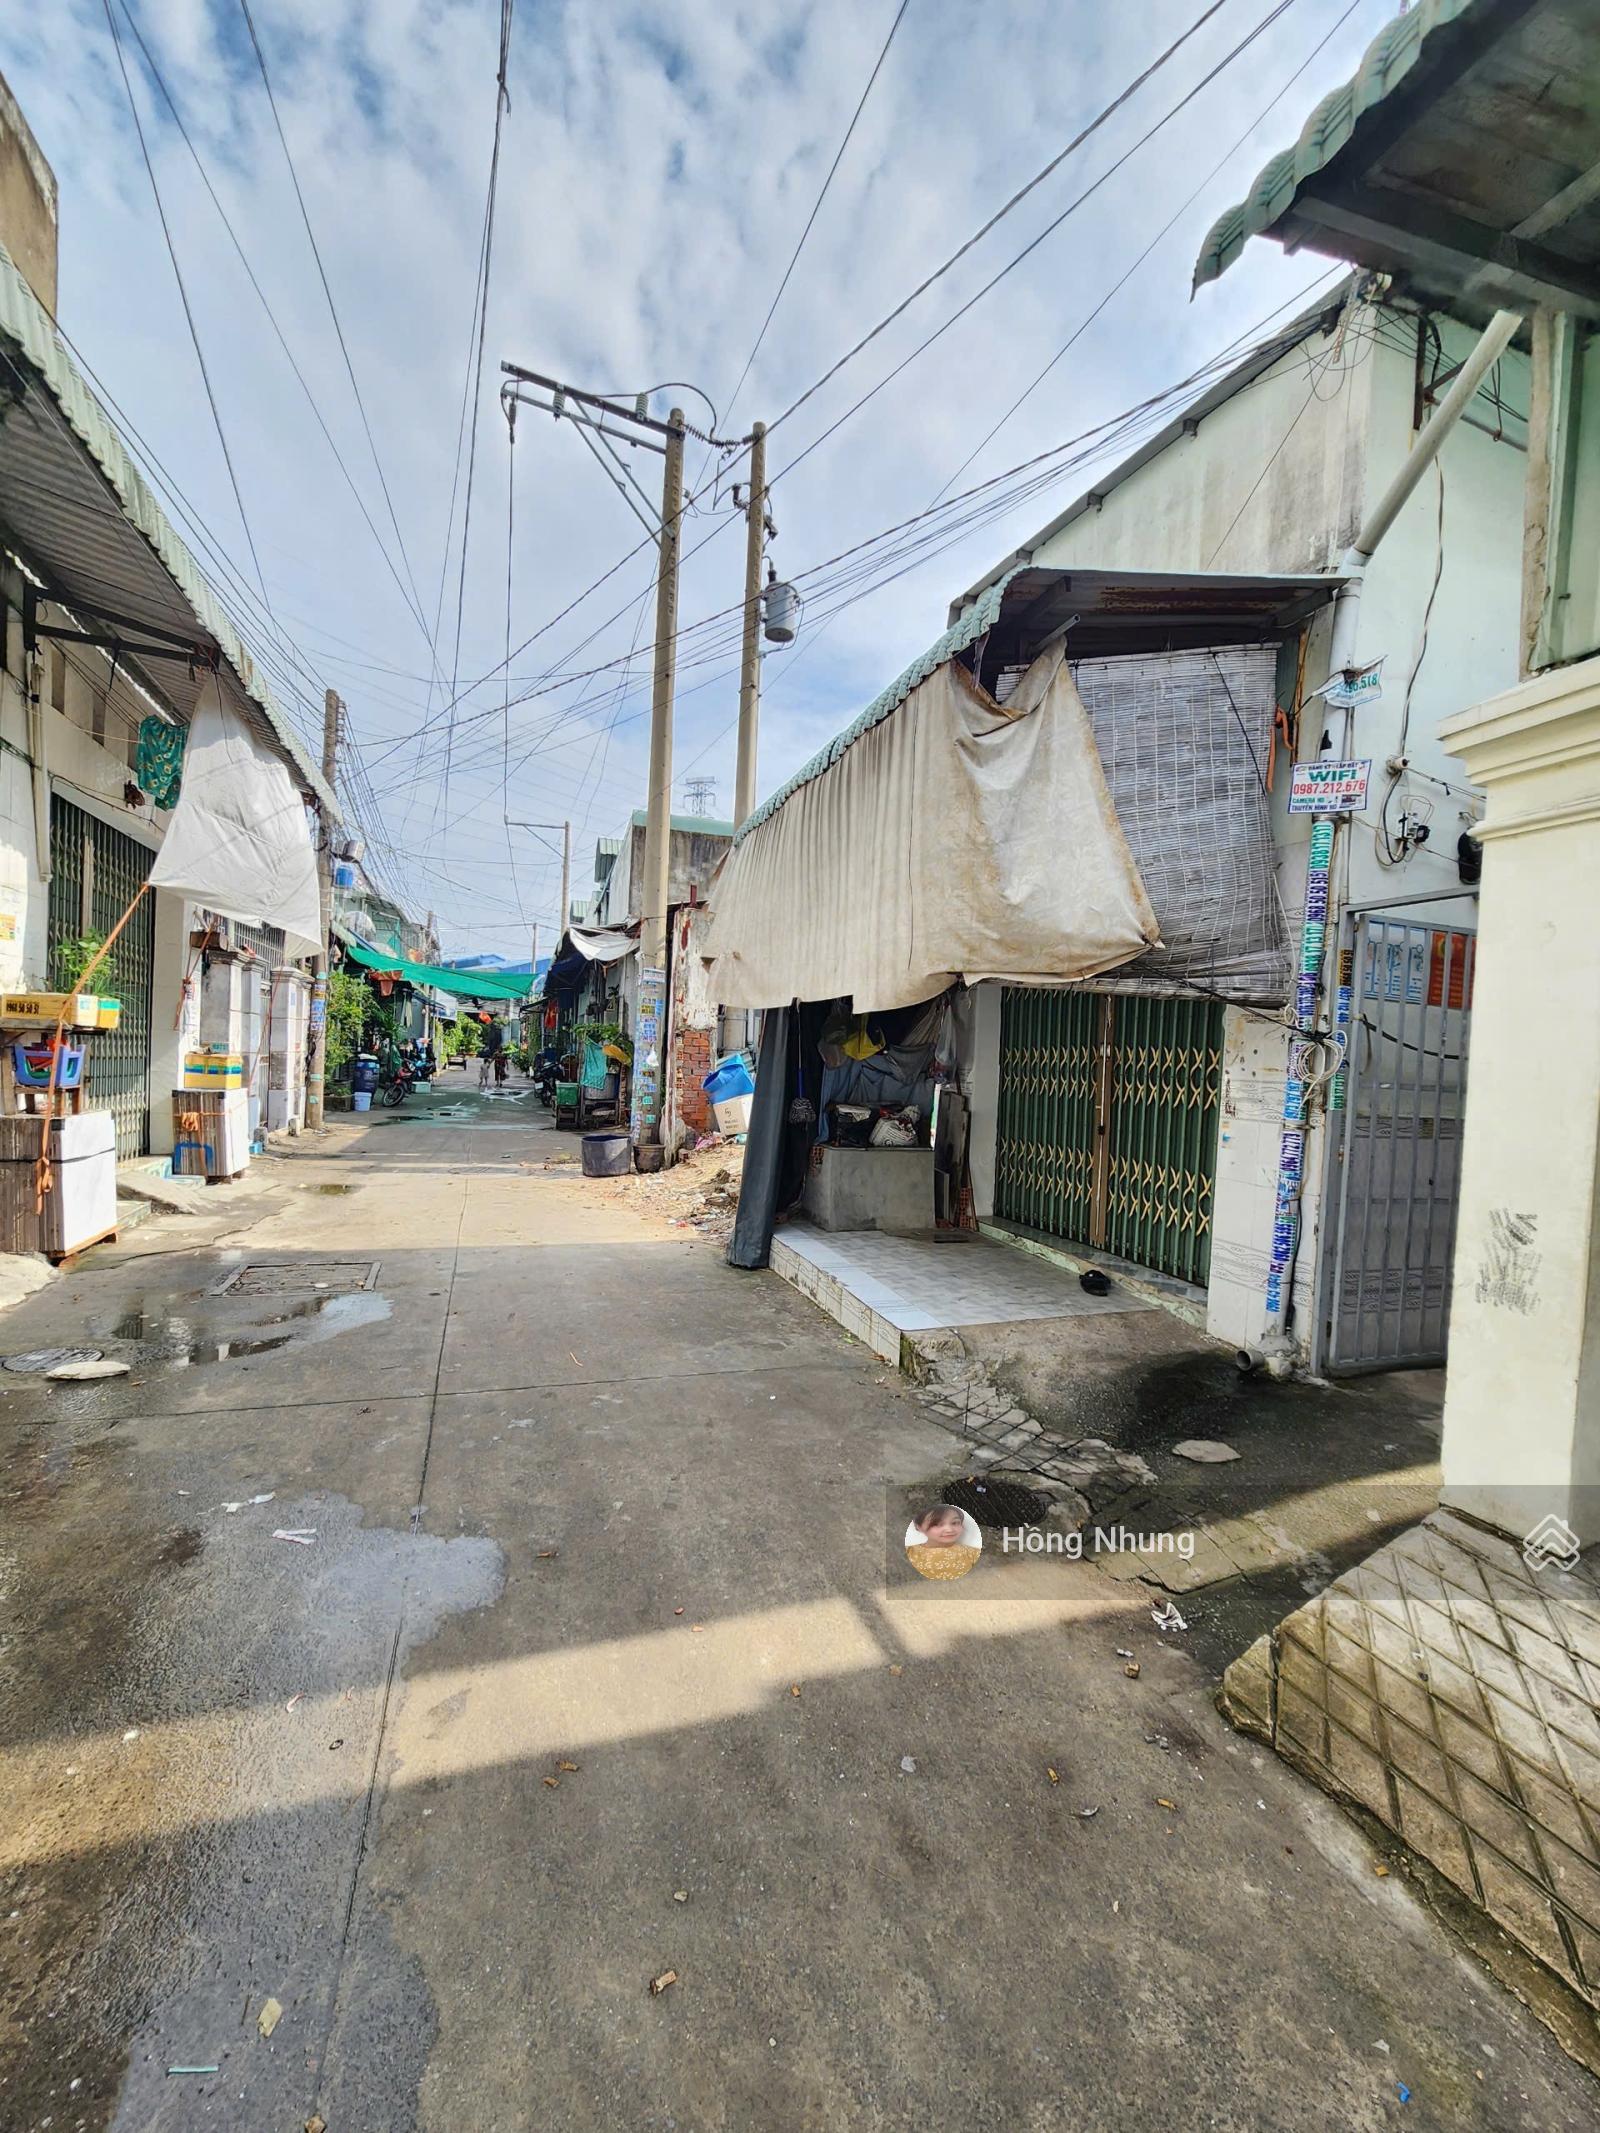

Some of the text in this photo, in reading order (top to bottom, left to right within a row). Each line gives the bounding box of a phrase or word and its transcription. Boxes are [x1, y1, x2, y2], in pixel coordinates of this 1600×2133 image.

[1308, 769, 1357, 782] WIFI
[1293, 780, 1366, 795] 0987.212.676
[1313, 832, 1330, 841] 13
[1310, 850, 1328, 868] 0938
[1309, 886, 1327, 894] 50
[1309, 896, 1326, 904] 50
[1307, 906, 1326, 922] 0968
